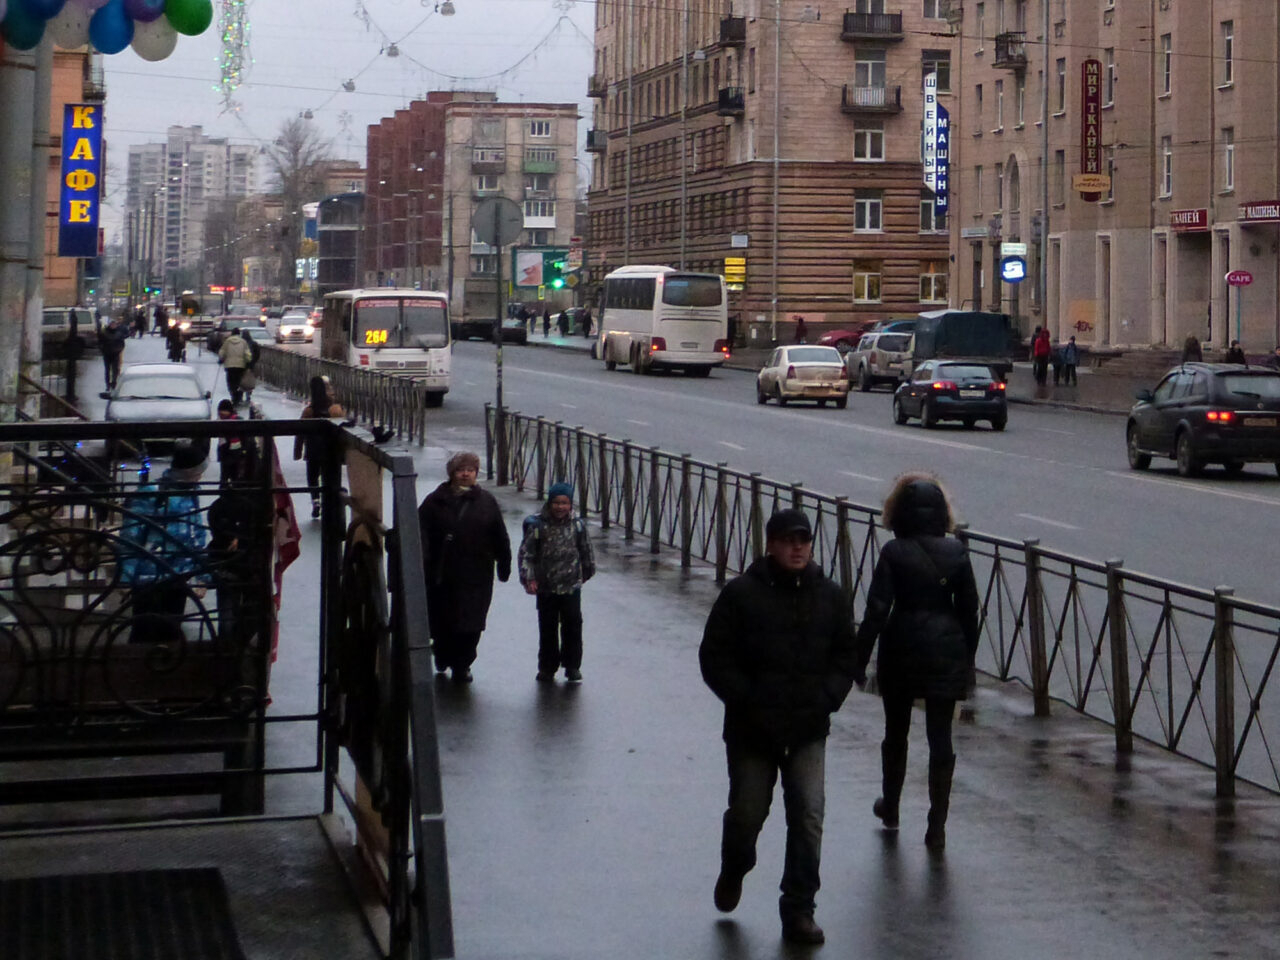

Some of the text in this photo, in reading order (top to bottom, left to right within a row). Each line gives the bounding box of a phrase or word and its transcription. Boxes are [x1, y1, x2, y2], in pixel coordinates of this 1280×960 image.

[65, 106, 96, 223] КАФЕ
[925, 78, 936, 182] ШВЕЙНЫЕ
[937, 119, 948, 206] МАШИНЫ
[1086, 63, 1098, 172] МИР ТКАНЕЙ
[1247, 205, 1280, 218] МАШИНЫ
[365, 329, 387, 344] 264
